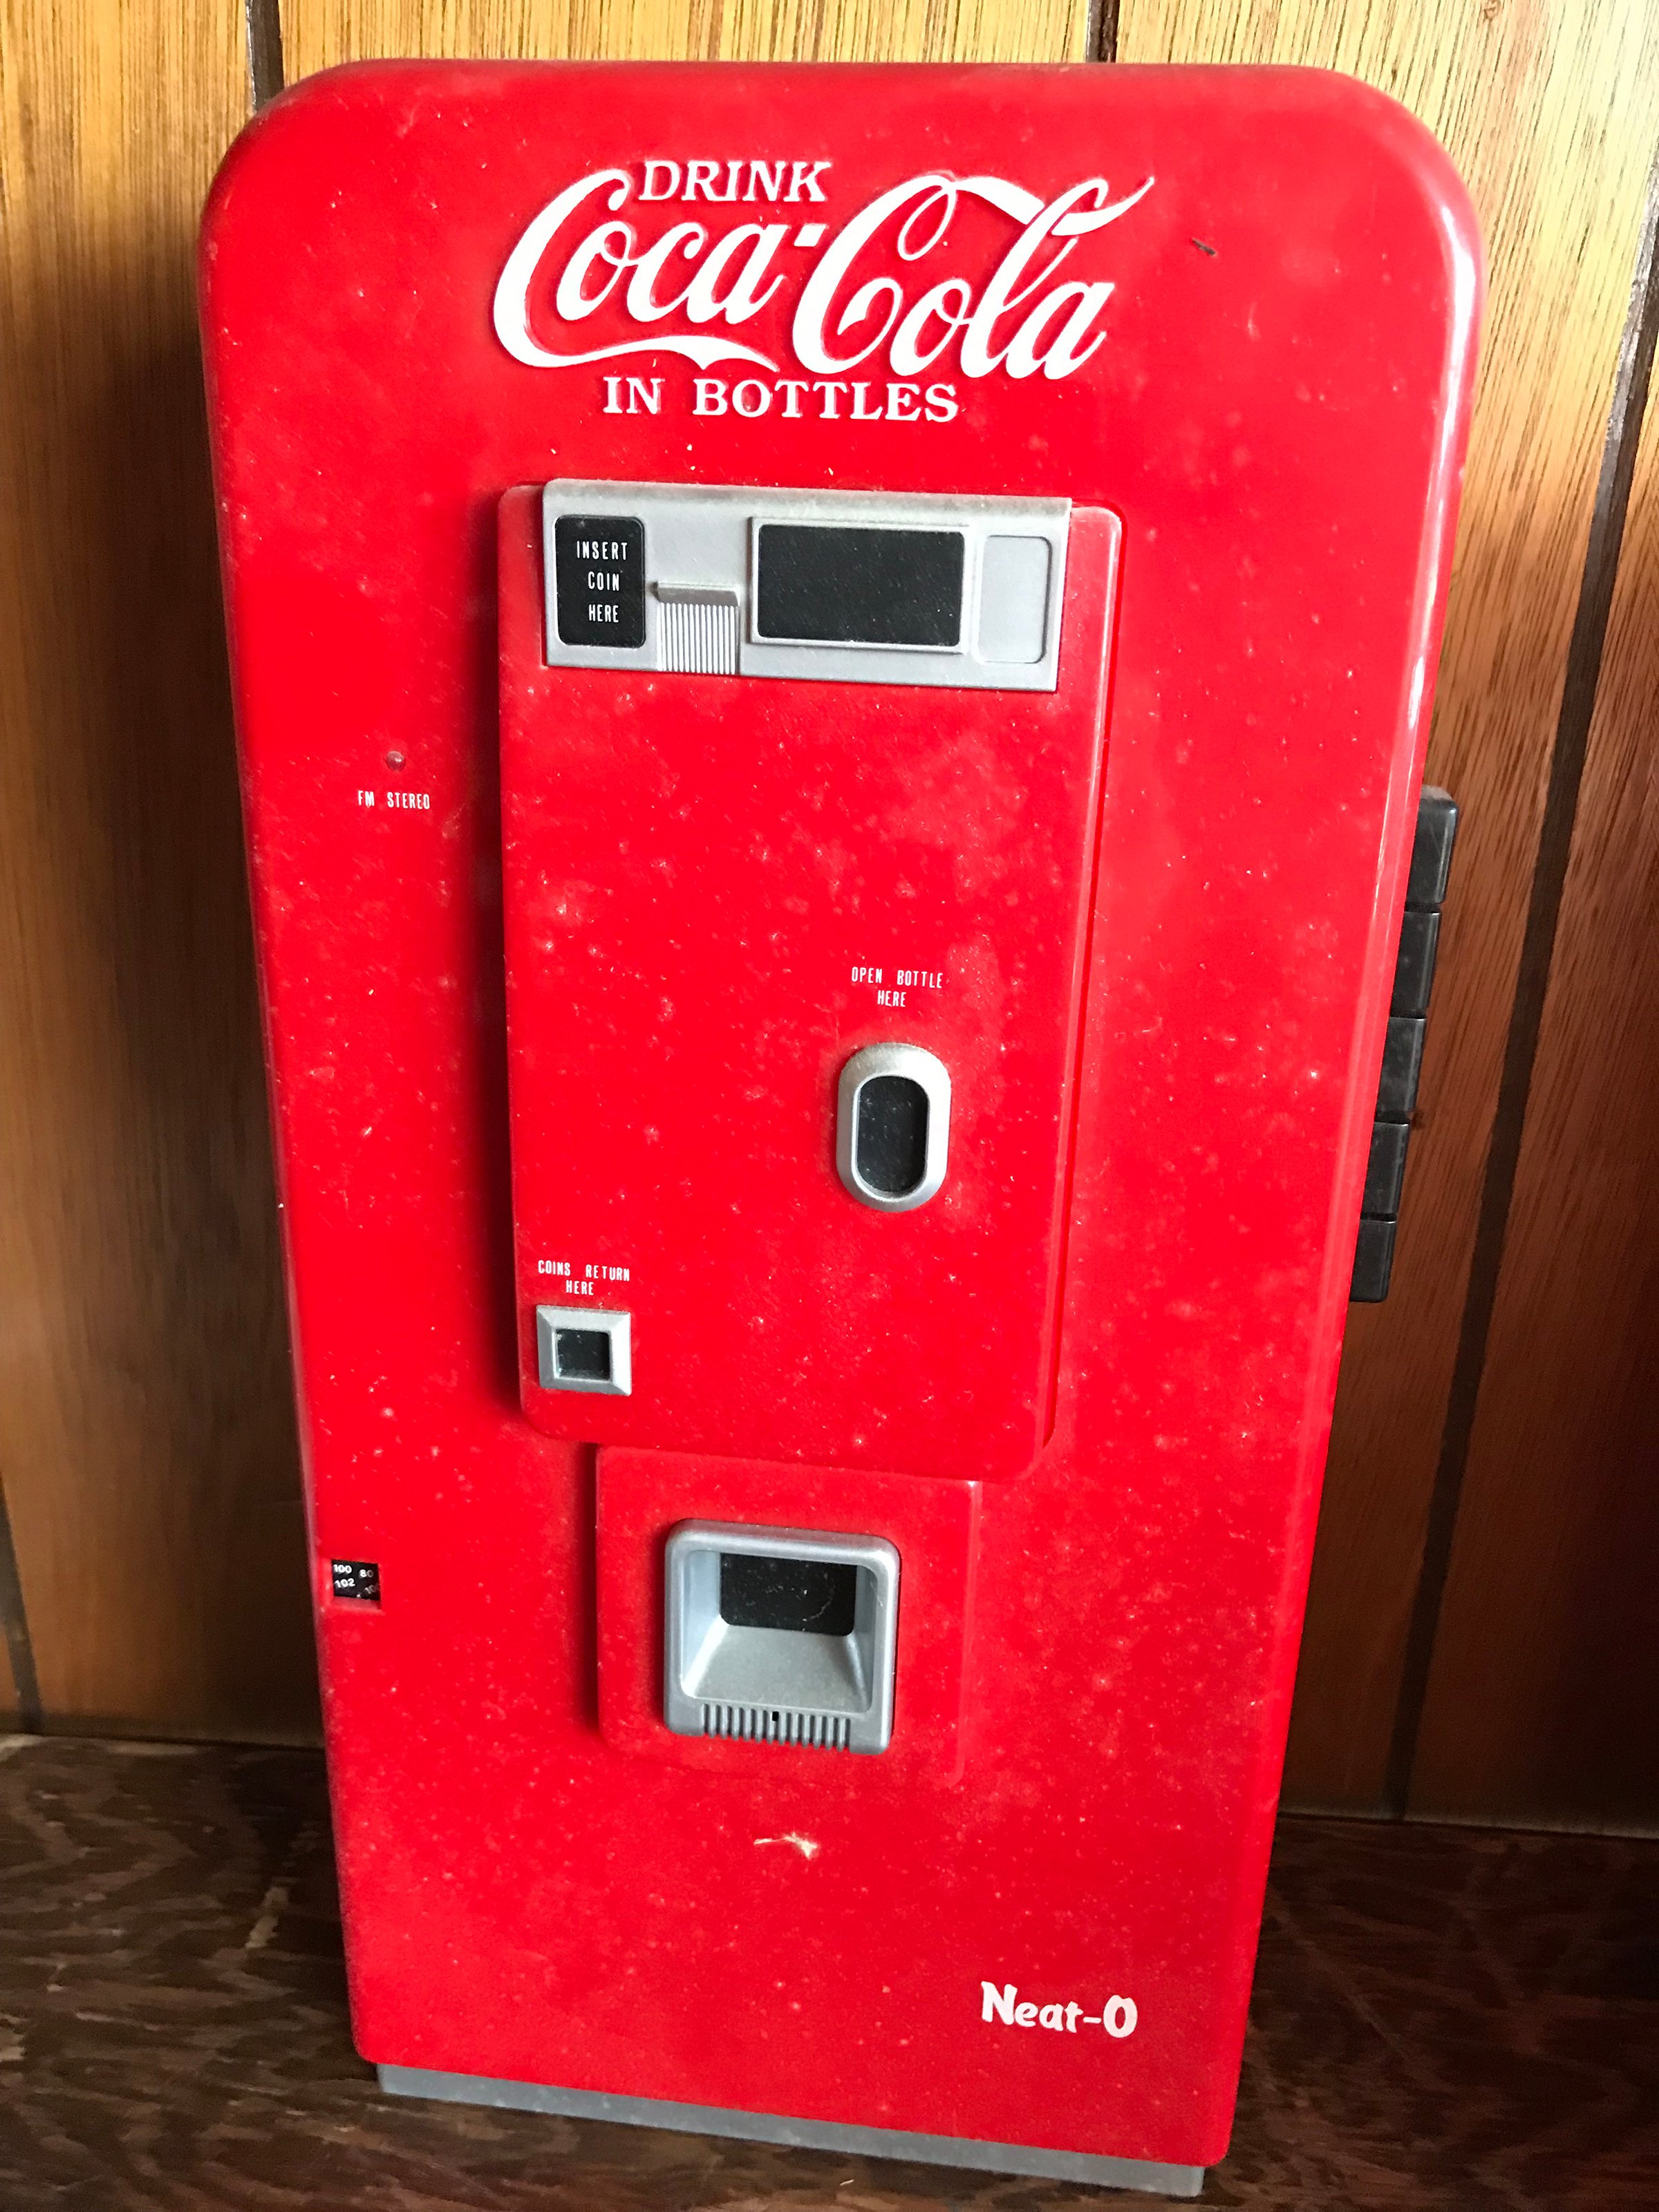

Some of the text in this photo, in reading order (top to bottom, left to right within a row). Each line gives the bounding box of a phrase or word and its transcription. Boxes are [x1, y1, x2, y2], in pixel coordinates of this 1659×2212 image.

[638, 159, 832, 203] DRINK
[492, 168, 1156, 381] Coca-Cola
[602, 376, 959, 424] IN BOTTLES
[576, 539, 628, 561] INSERT
[587, 571, 620, 592] COIN
[588, 603, 620, 624] HERE
[357, 789, 431, 810] FM STEREO
[850, 966, 944, 989] OPEN BOTTLE
[877, 988, 908, 1008] HERE
[537, 1259, 630, 1282] COINS RETURN
[565, 1279, 595, 1296] HERE
[332, 1564, 353, 1574] 100
[335, 1577, 356, 1588] 102
[980, 1980, 1138, 2039] Neat-O
